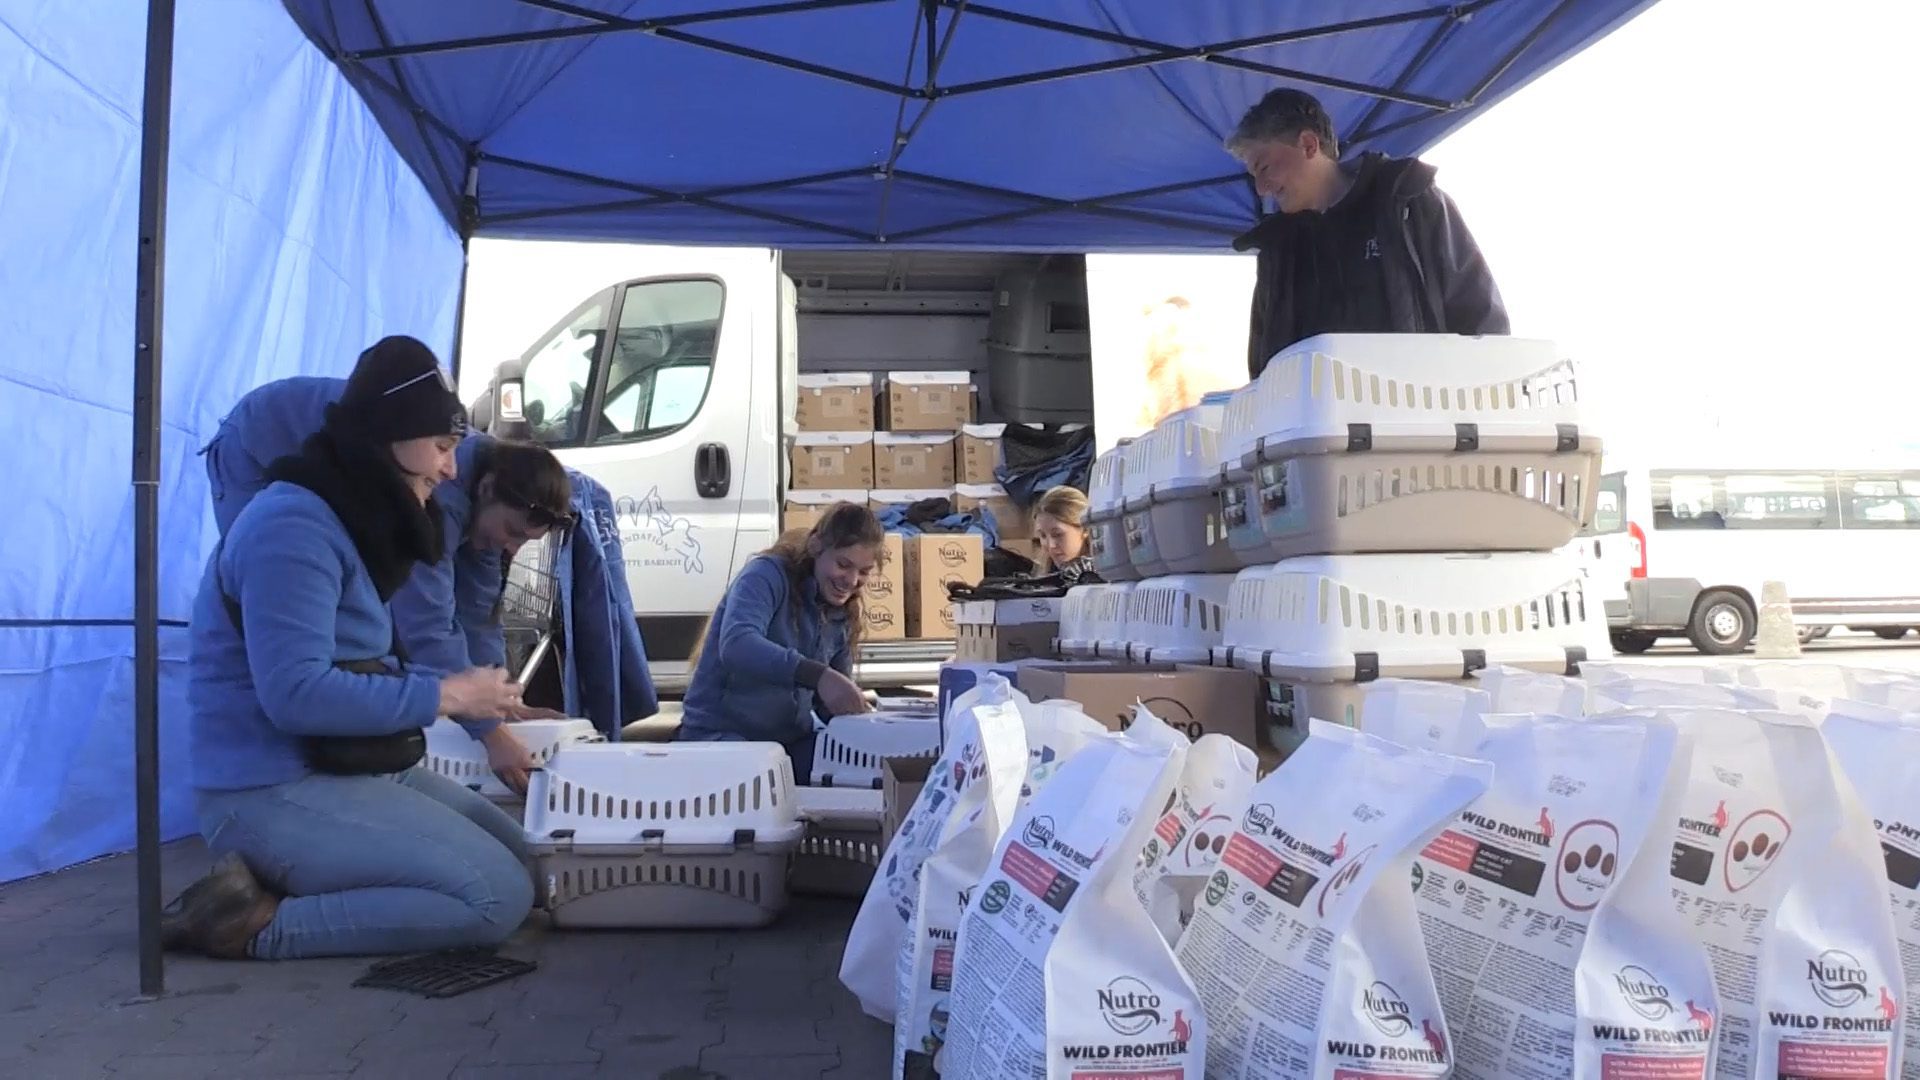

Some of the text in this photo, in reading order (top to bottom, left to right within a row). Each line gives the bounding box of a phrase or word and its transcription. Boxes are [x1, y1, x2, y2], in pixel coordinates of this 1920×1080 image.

[938, 546, 967, 561] Nutro
[1271, 825, 1300, 851] WILD
[1461, 810, 1551, 848] WILD FRONTIER
[1806, 959, 1867, 983] Nutro
[1612, 972, 1669, 998] Nutro
[1096, 989, 1161, 1012] Nutro
[1362, 988, 1409, 1015] Nutro
[1592, 1025, 1641, 1041] WILD
[1768, 1011, 1892, 1032] WILD FRONTIER
[1062, 1041, 1189, 1059] WILD FRONTIER
[1327, 1040, 1446, 1064] WILD FRONTIER
